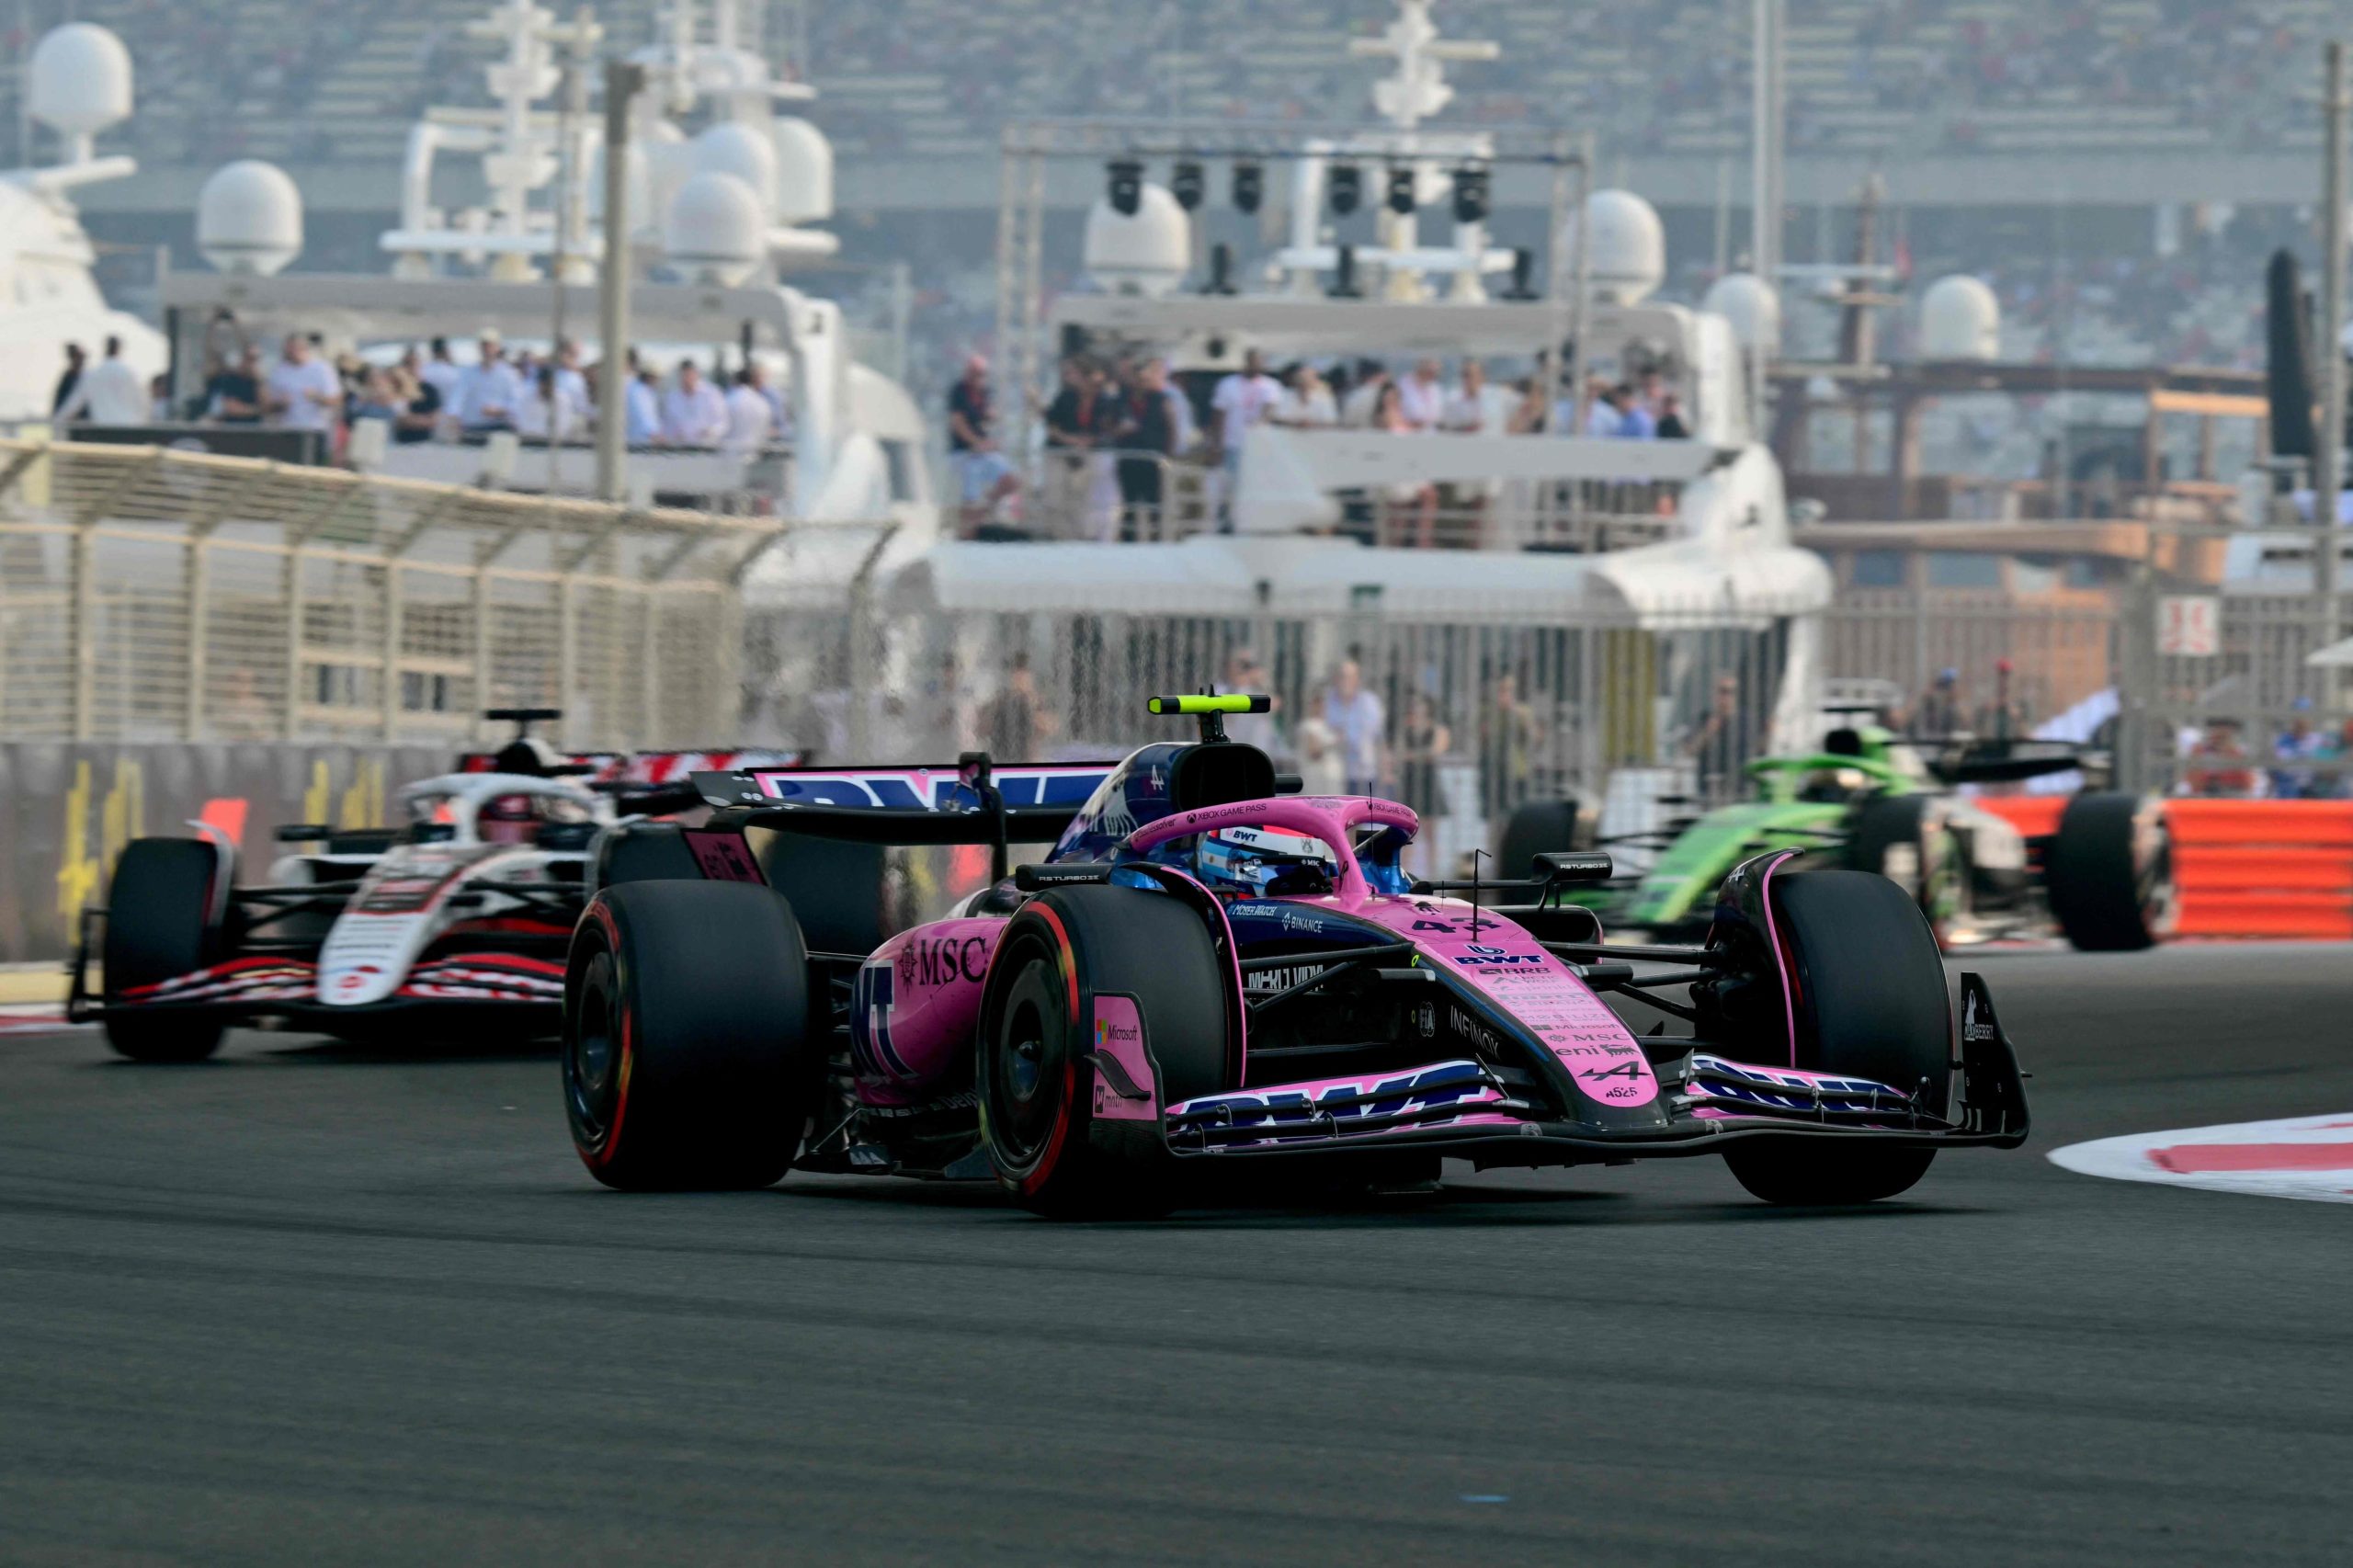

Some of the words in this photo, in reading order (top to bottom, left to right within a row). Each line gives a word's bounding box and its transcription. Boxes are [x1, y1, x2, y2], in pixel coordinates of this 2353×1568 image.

[1198, 812, 1220, 821] XBOX
[1221, 807, 1245, 817] GAME
[1245, 803, 1267, 813] PASS
[1233, 830, 1257, 843] BWT
[1291, 915, 1323, 934] BINANCE
[1412, 918, 1502, 933] 43
[919, 937, 986, 986] MSC
[1452, 955, 1544, 965] BWT
[1503, 967, 1552, 975] BRB
[1419, 1008, 1434, 1030] FIA
[1108, 1024, 1138, 1041] Microsoft
[1571, 1033, 1631, 1042] MSC
[1554, 1045, 1600, 1057] eni
